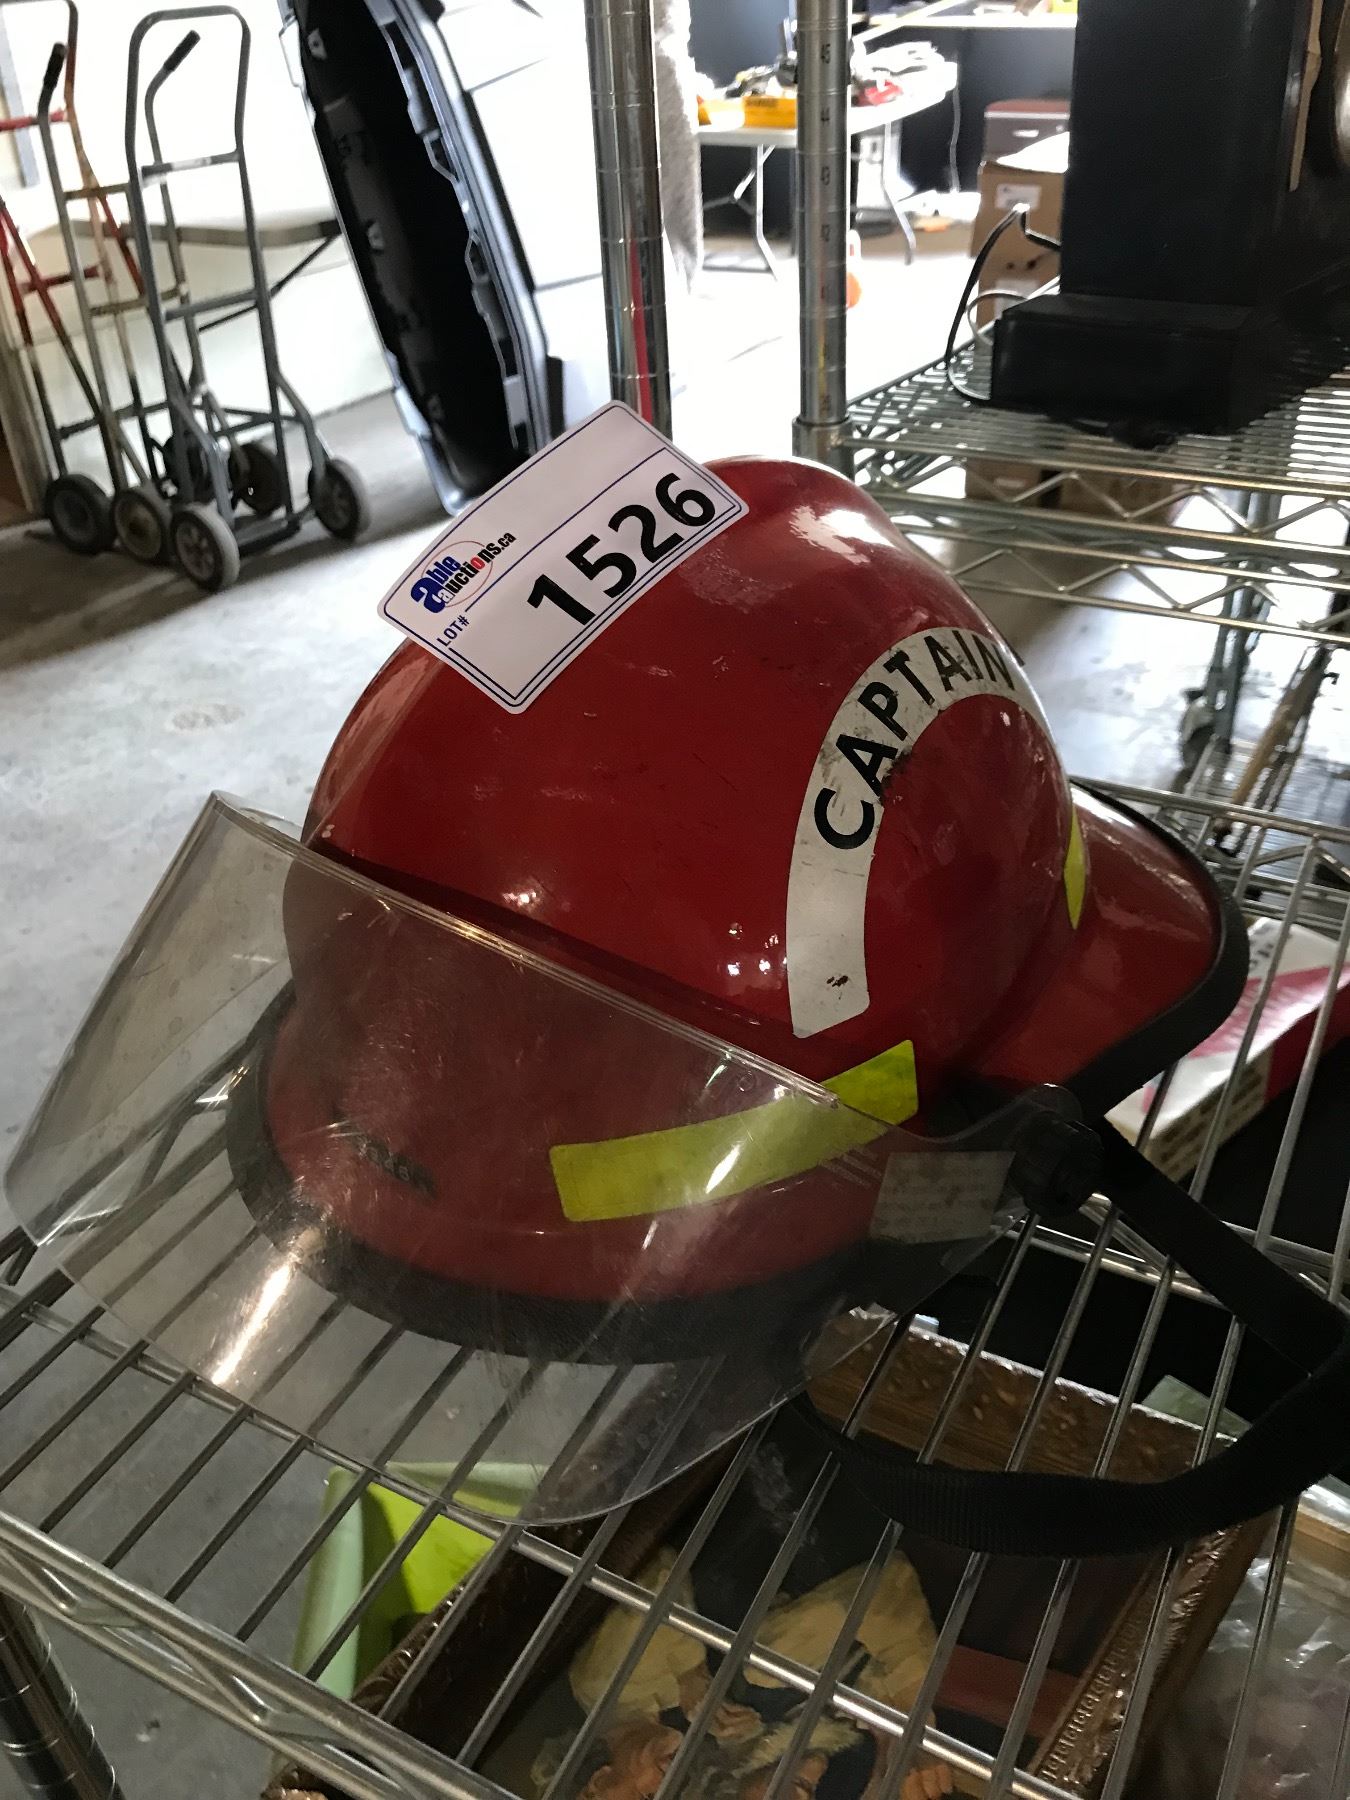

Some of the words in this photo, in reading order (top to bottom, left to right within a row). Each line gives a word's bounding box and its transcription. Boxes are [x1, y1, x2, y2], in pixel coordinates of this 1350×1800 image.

[436, 615, 470, 647] LOT#
[526, 472, 716, 626] 1526
[437, 532, 517, 604] auctions.ca
[814, 630, 1025, 850] CAPTAIN
